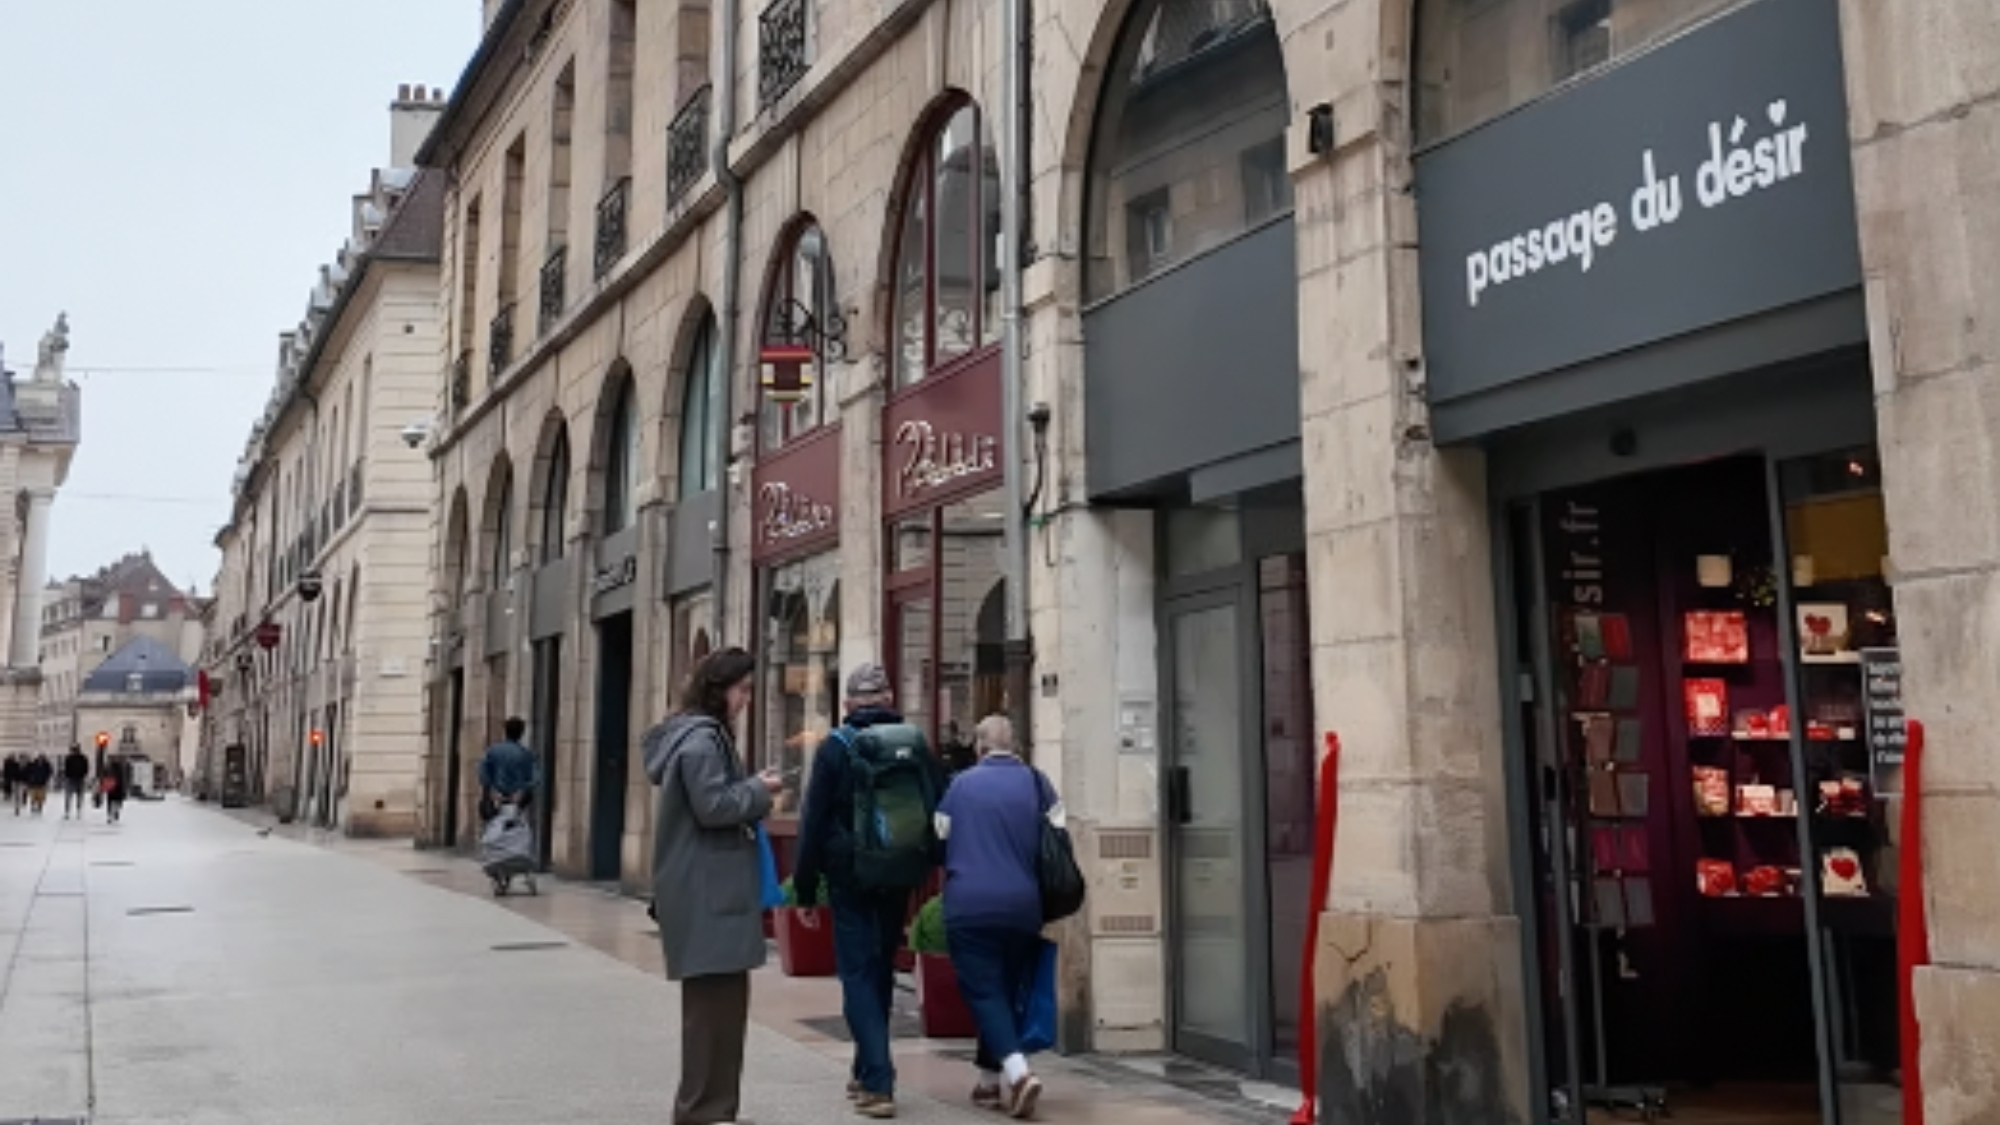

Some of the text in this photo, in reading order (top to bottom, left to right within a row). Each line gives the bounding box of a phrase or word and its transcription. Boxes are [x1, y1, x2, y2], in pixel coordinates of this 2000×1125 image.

[1466, 98, 1808, 306] passage du désir
[1561, 500, 1603, 613] sir.fr
